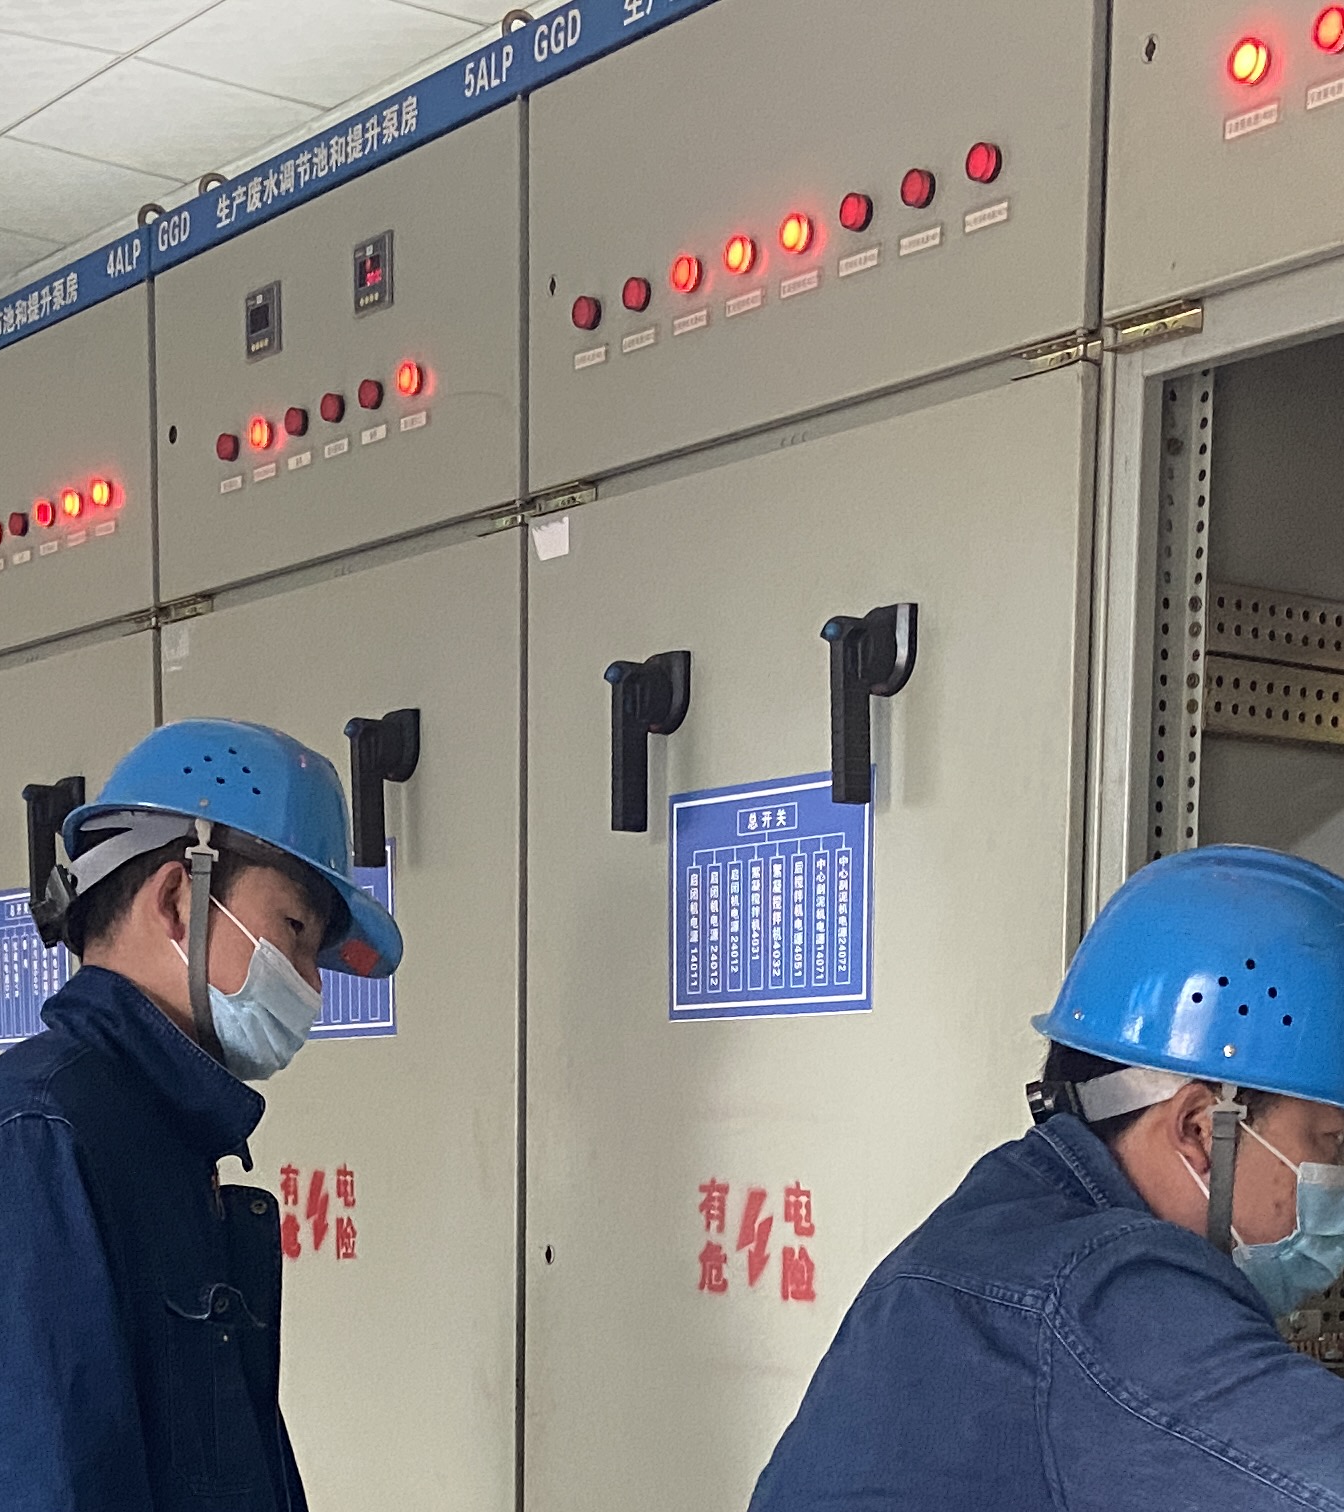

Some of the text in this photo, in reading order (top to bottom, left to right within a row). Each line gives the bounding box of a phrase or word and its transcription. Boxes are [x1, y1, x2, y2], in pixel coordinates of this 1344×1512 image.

[533, 8, 582, 63] GGD
[464, 44, 514, 97] 5ALP
[158, 95, 419, 252] GGD 生产废水调节池和提升泵房
[107, 238, 141, 279] 4ALP
[747, 808, 787, 830] 总开关
